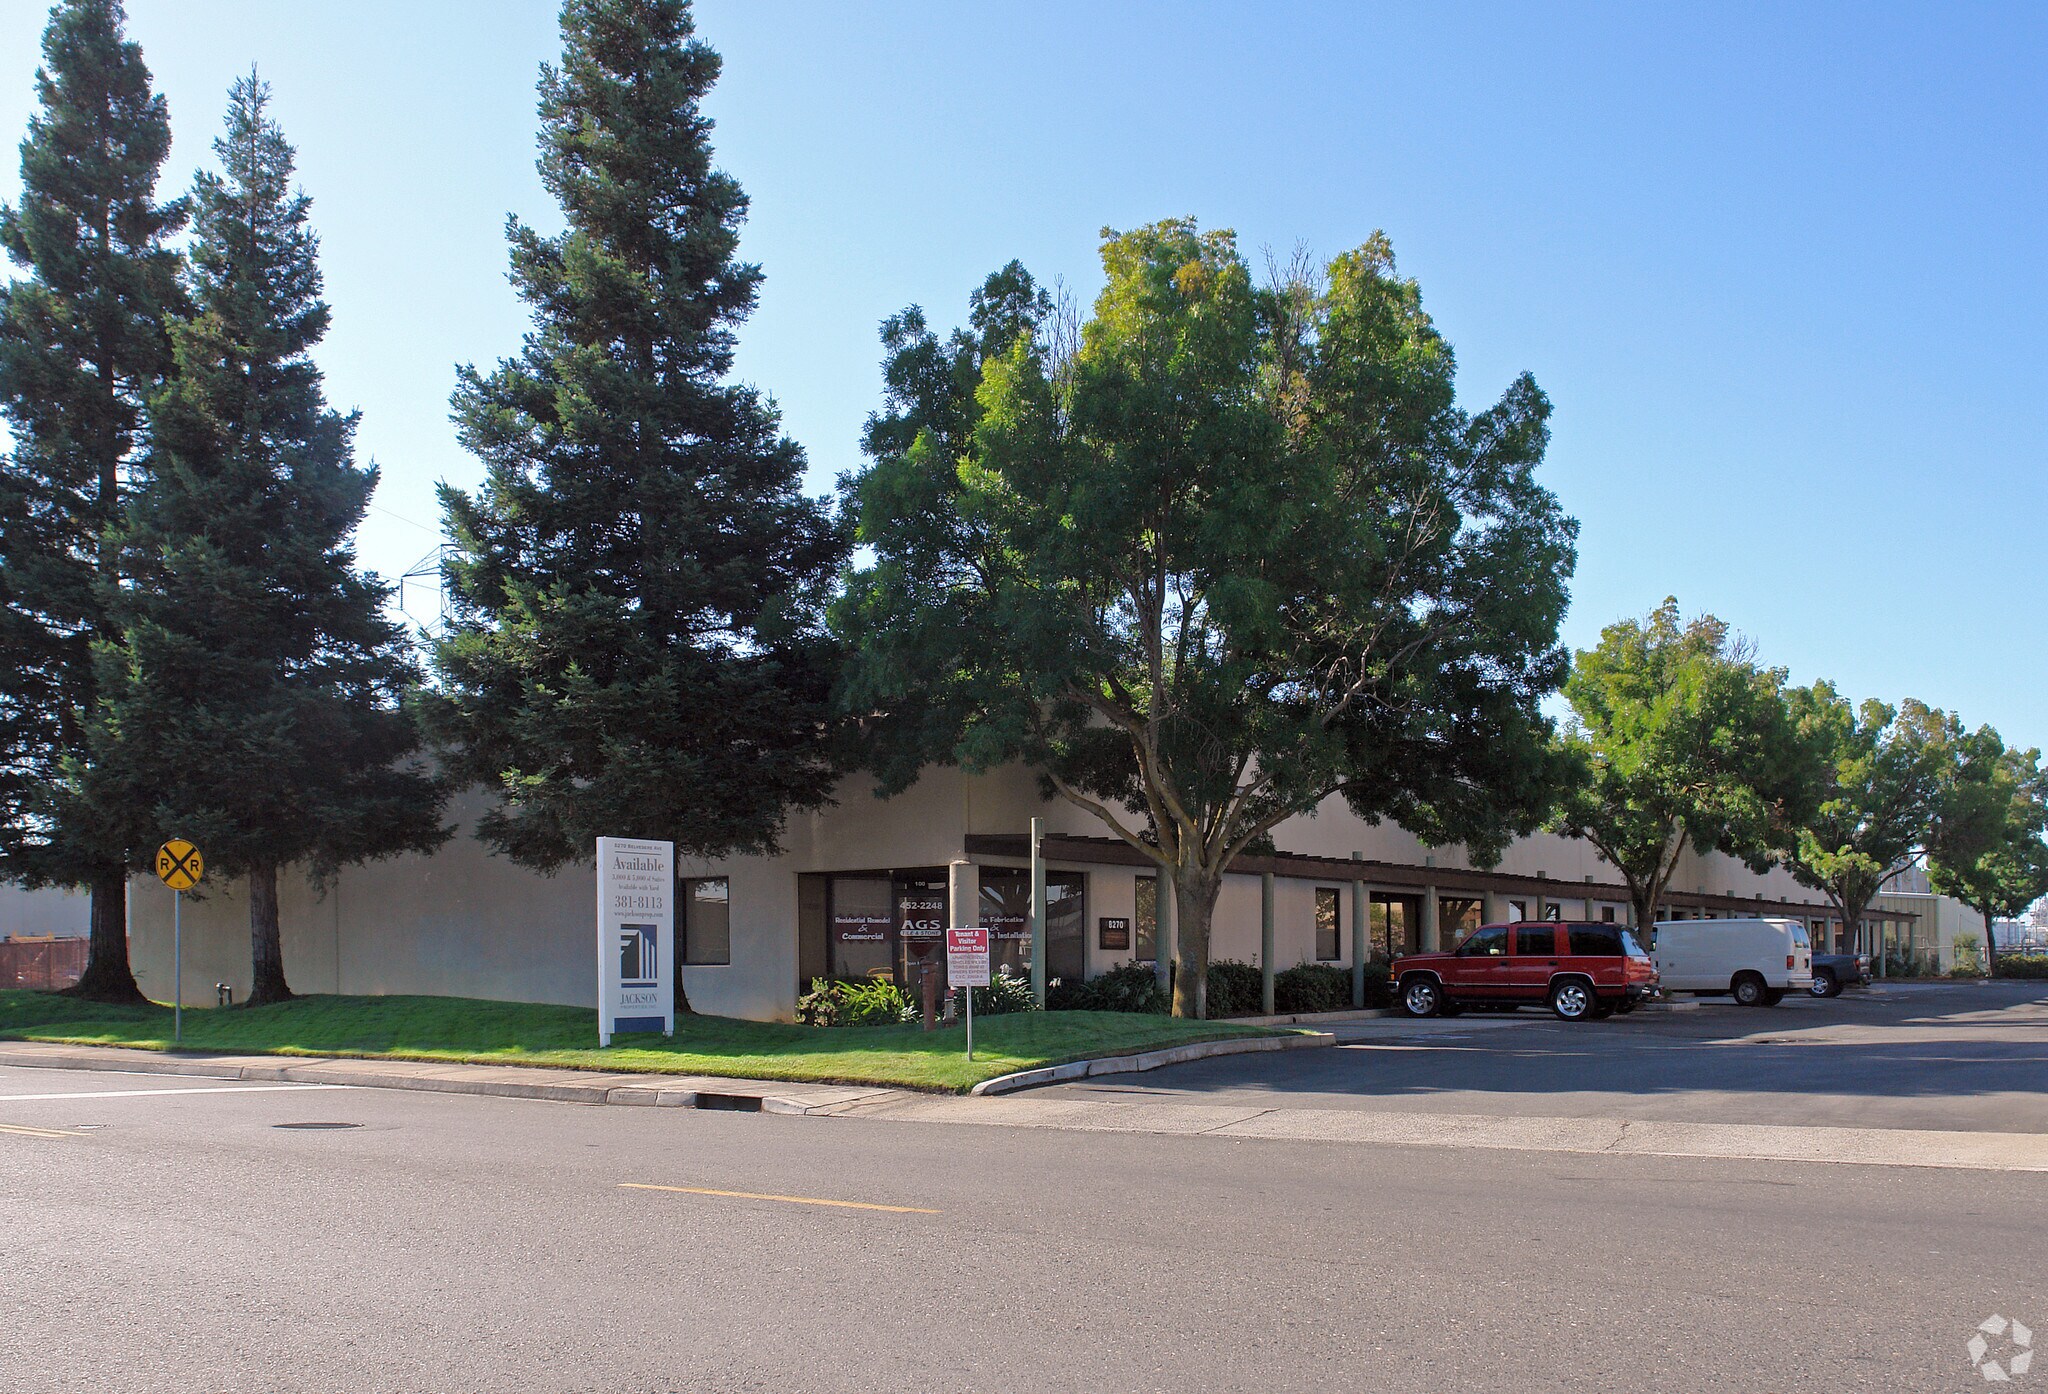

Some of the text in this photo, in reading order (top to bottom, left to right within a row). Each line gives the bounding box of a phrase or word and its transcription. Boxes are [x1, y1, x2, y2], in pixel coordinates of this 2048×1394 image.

[612, 856, 664, 872] Available
[615, 895, 663, 909] 381-8113
[900, 901, 943, 910] 452-2248
[858, 924, 868, 932] &
[901, 919, 941, 930] AGS
[990, 923, 1000, 931] &
[1108, 920, 1124, 929] 8270
[842, 932, 884, 940] Commercial
[972, 945, 986, 953] Only
[620, 993, 658, 1005] JACKSON
